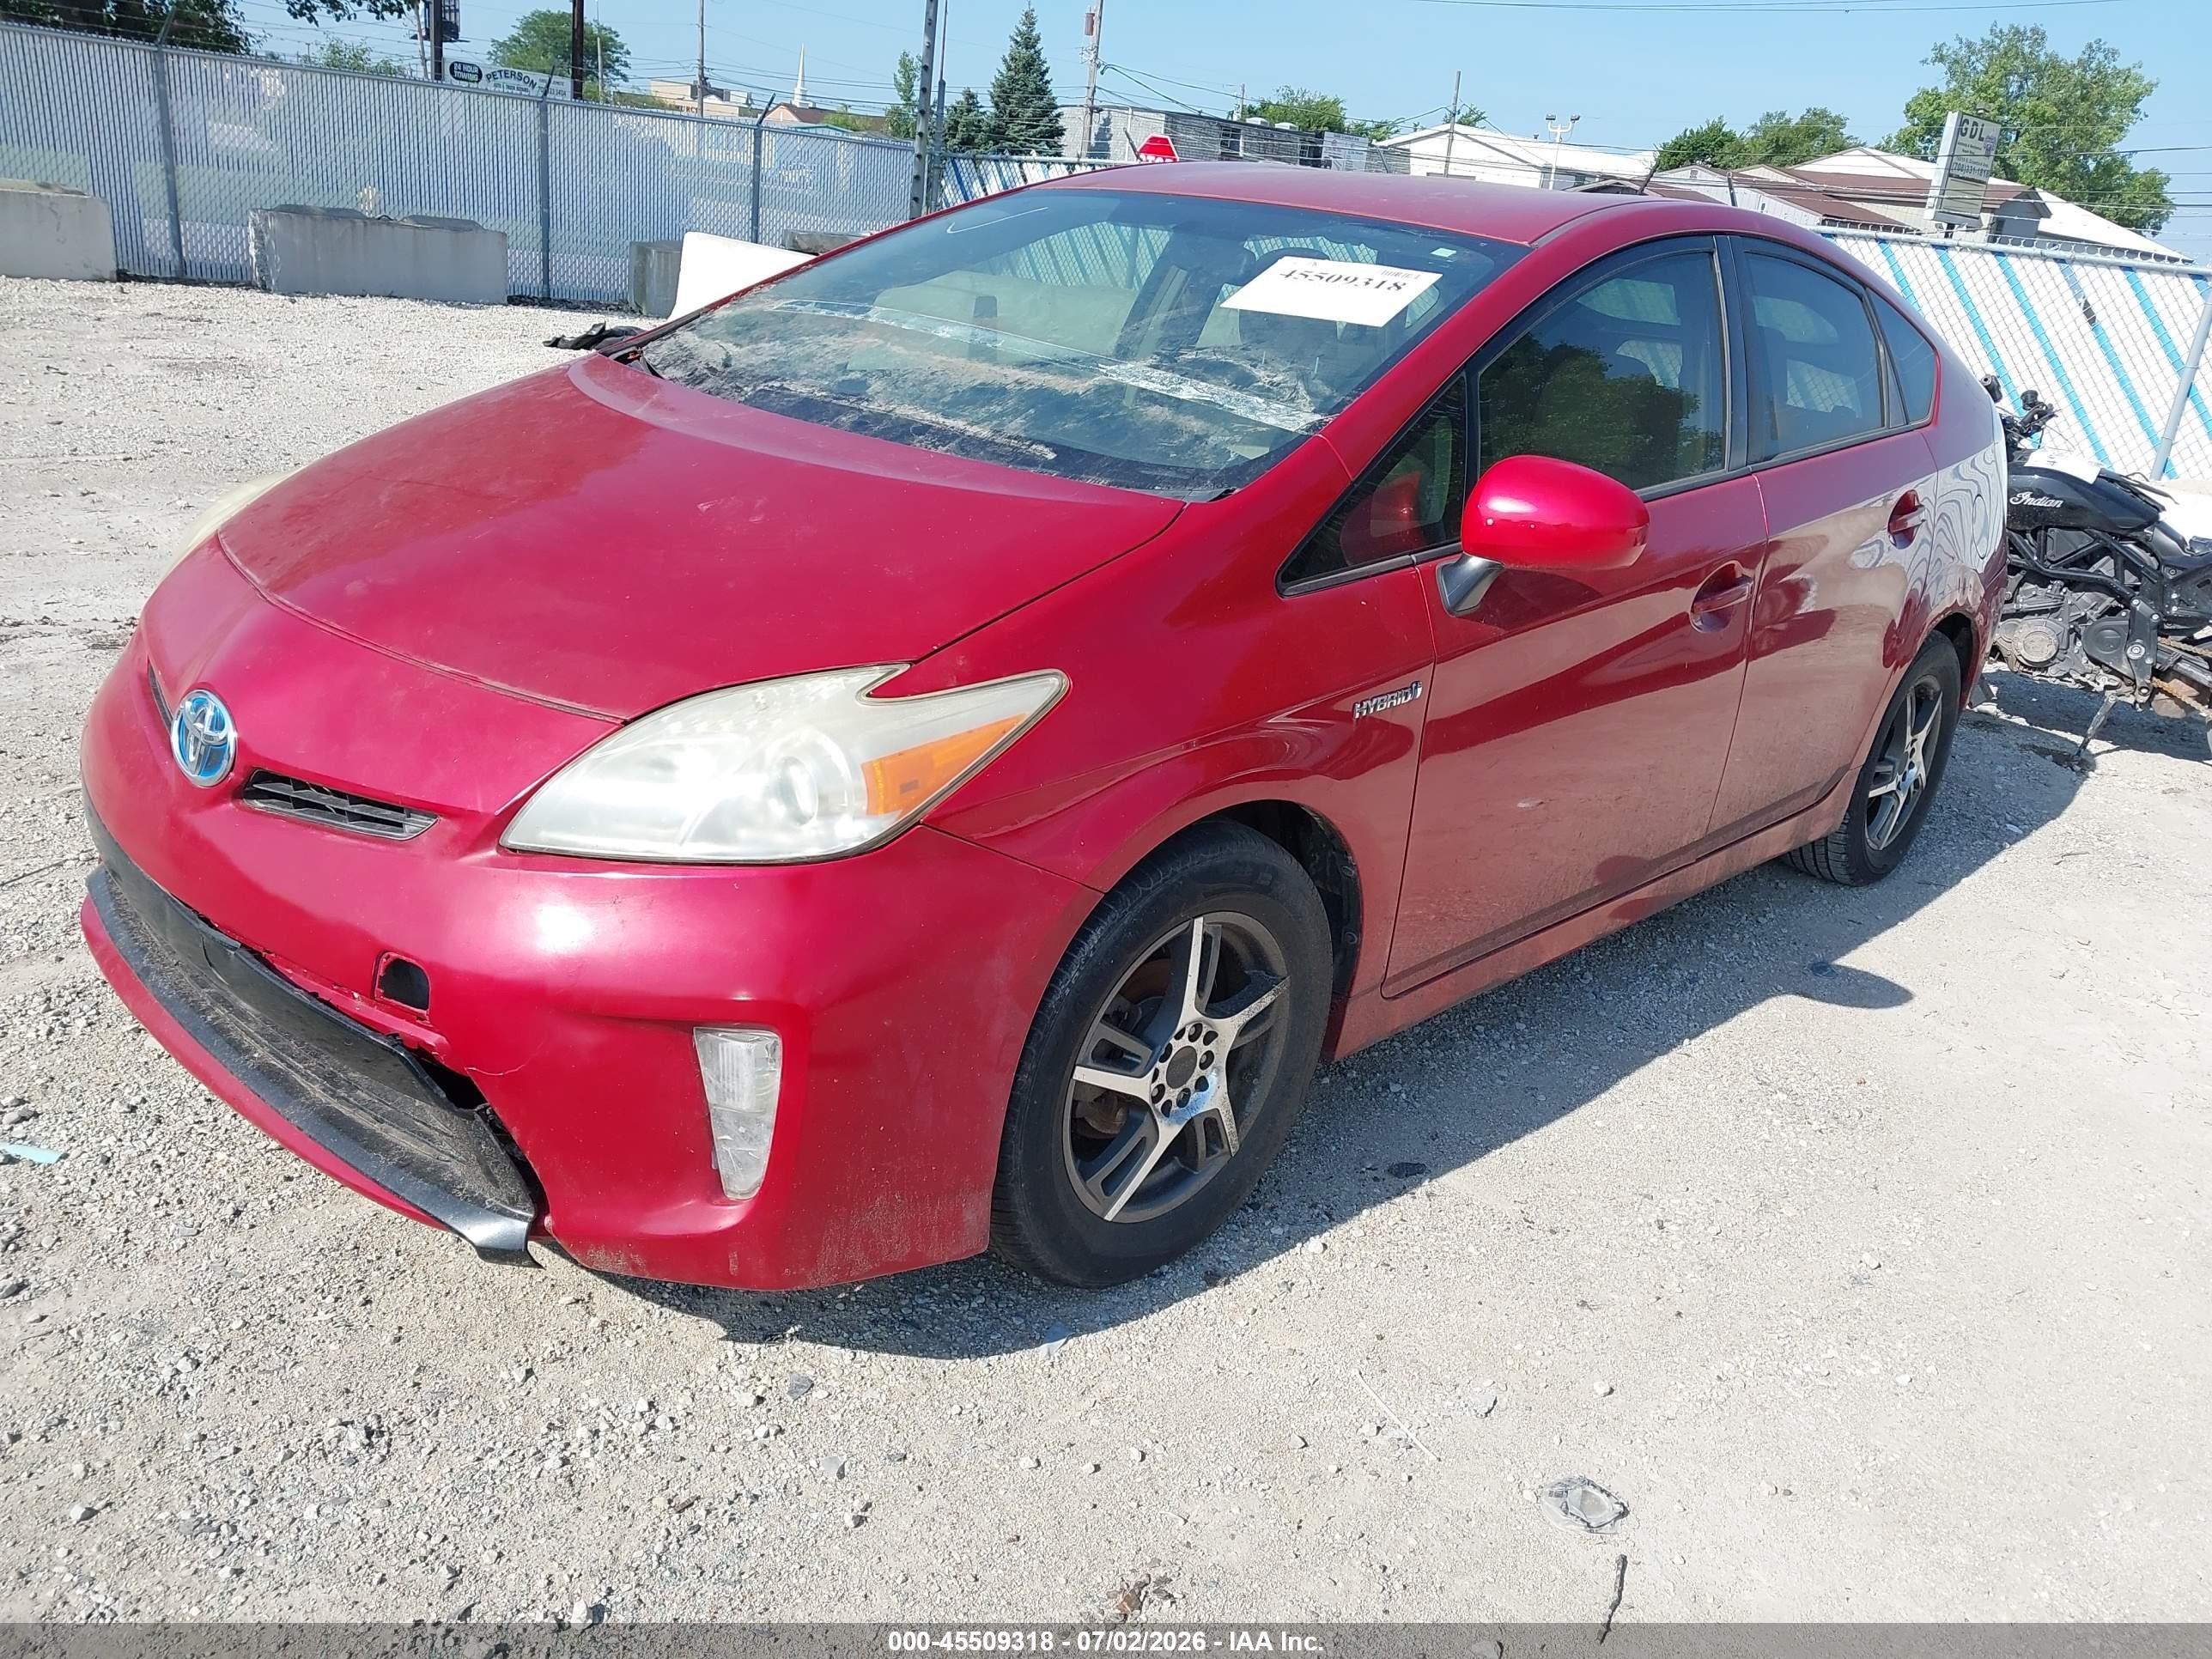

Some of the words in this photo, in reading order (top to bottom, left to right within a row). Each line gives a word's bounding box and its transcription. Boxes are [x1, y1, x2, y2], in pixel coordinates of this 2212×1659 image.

[453, 70, 478, 81] TOWING
[462, 64, 478, 73] HOUR
[485, 70, 537, 89] PETERSON
[1960, 118, 1984, 142] GDL
[1279, 269, 1407, 291] 45509318
[2009, 491, 2063, 507] Indian
[1353, 690, 1411, 718] HYBRID
